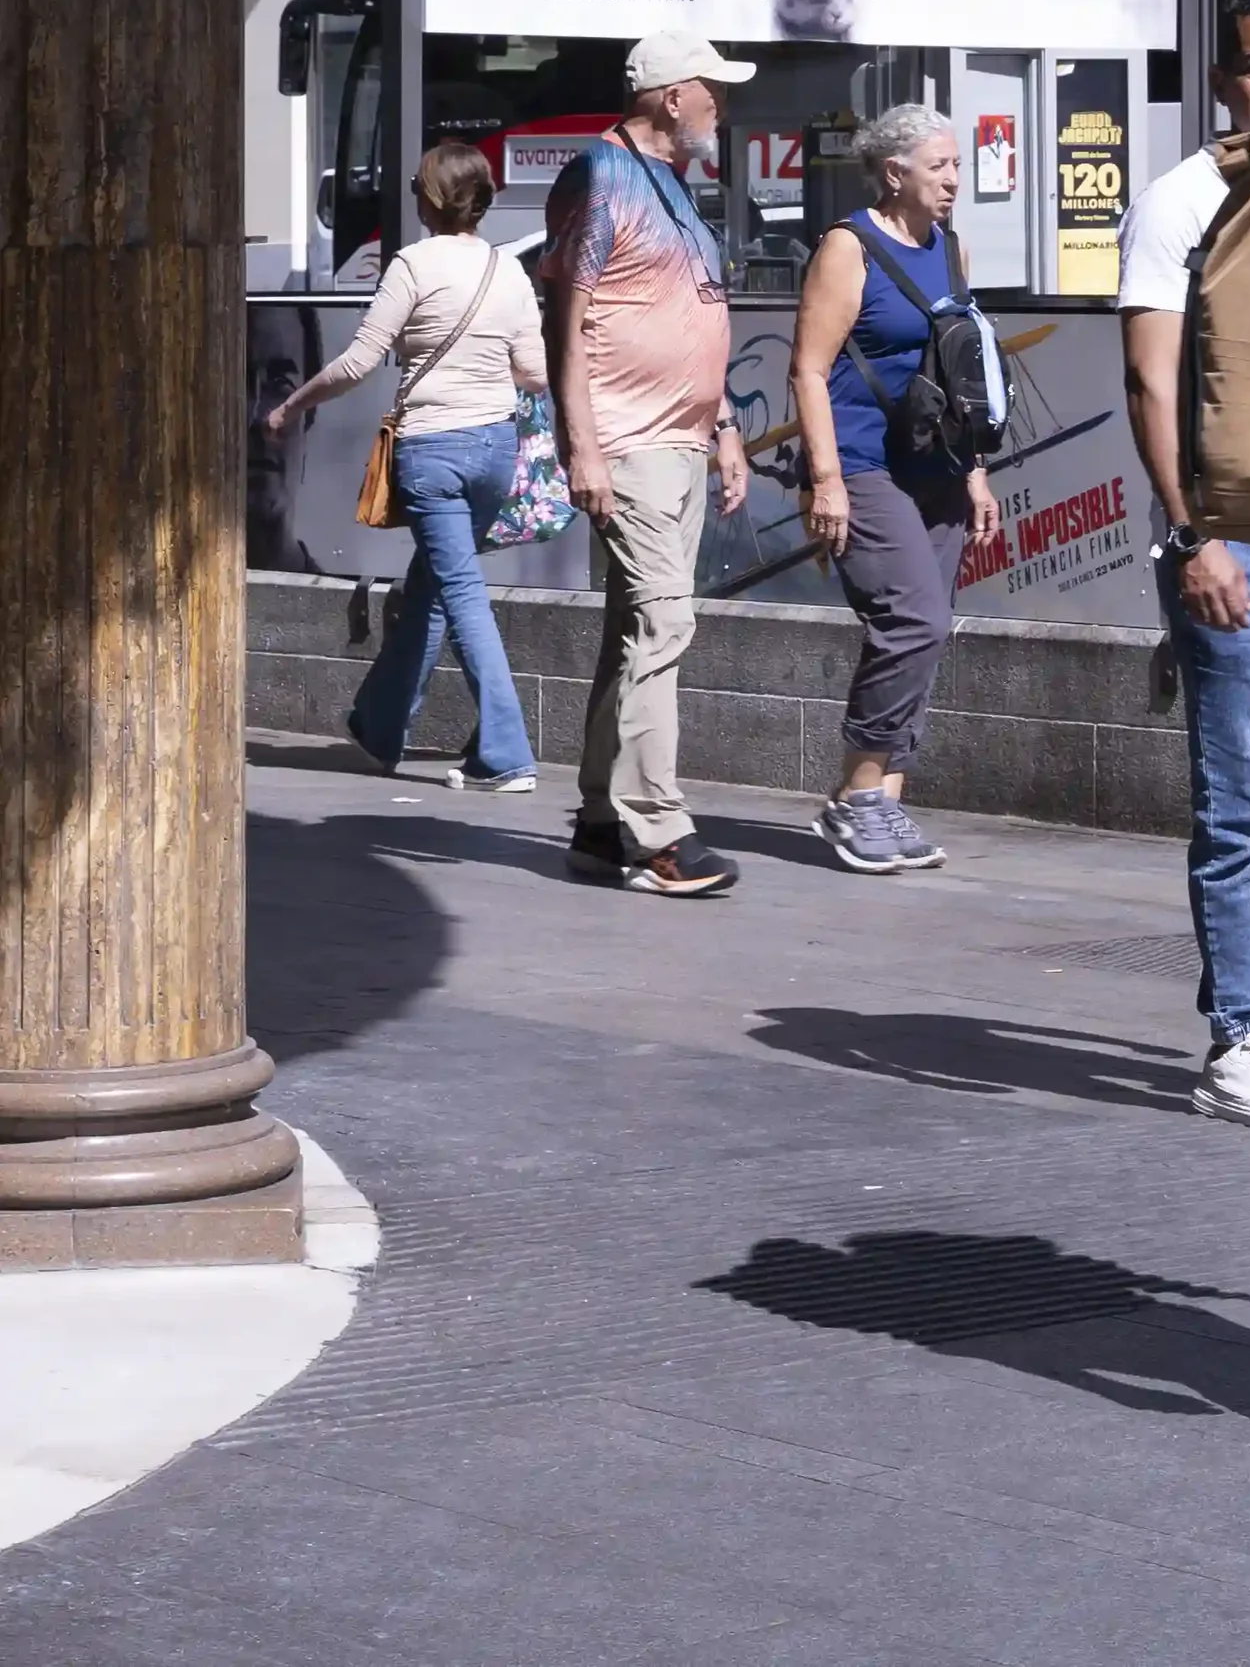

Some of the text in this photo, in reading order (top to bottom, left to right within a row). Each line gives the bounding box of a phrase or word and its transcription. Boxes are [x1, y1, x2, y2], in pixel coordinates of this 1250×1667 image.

[1059, 163, 1121, 197] 120
[1061, 198, 1120, 210] MILLONES
[1016, 476, 1127, 562] IMPOSIBLE
[1007, 523, 1130, 594] SENTENCIA FINAL
[1095, 565, 1108, 577] 23
[1109, 554, 1134, 571] MAYO
